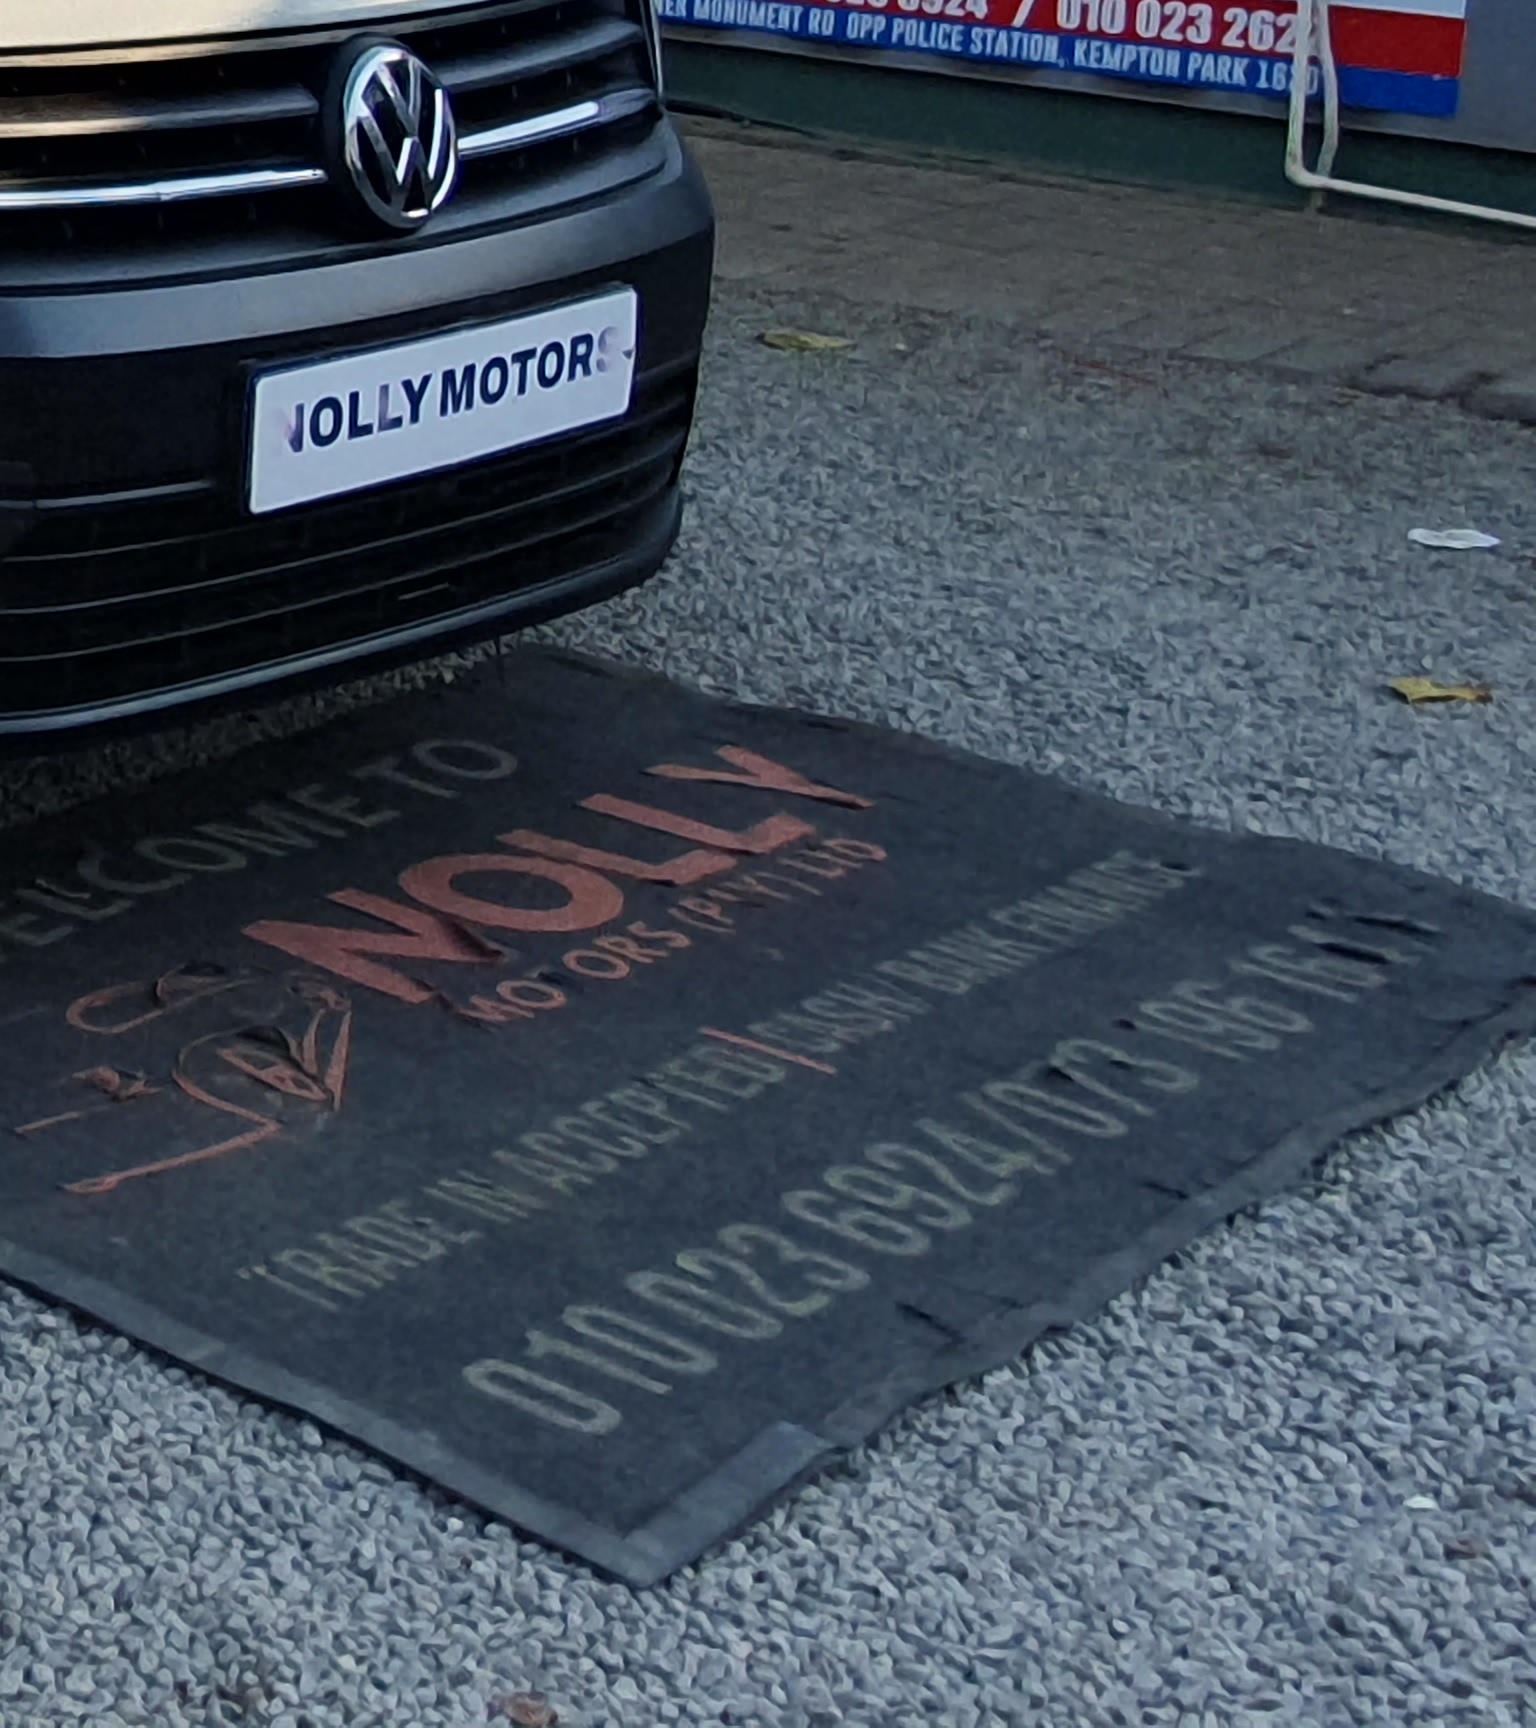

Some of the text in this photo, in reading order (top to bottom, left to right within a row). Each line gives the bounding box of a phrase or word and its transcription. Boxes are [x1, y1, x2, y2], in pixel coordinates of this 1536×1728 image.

[809, 8, 834, 36] RD
[845, 14, 885, 42] OPP
[891, 21, 963, 51] POLICE
[1074, 38, 1180, 78] KEMPTON
[1188, 52, 1249, 87] PARK
[1256, 60, 1320, 96] 160
[1221, 7, 1326, 54] 262
[353, 738, 520, 800] TO
[240, 744, 876, 1005] NOLLY
[459, 921, 691, 1024] MOORS
[236, 1192, 480, 1312] TRADE
[422, 1163, 530, 1221] IN
[486, 1040, 790, 1199] ACCEPTED
[462, 1302, 722, 1435] 010
[626, 1221, 872, 1342] 023
